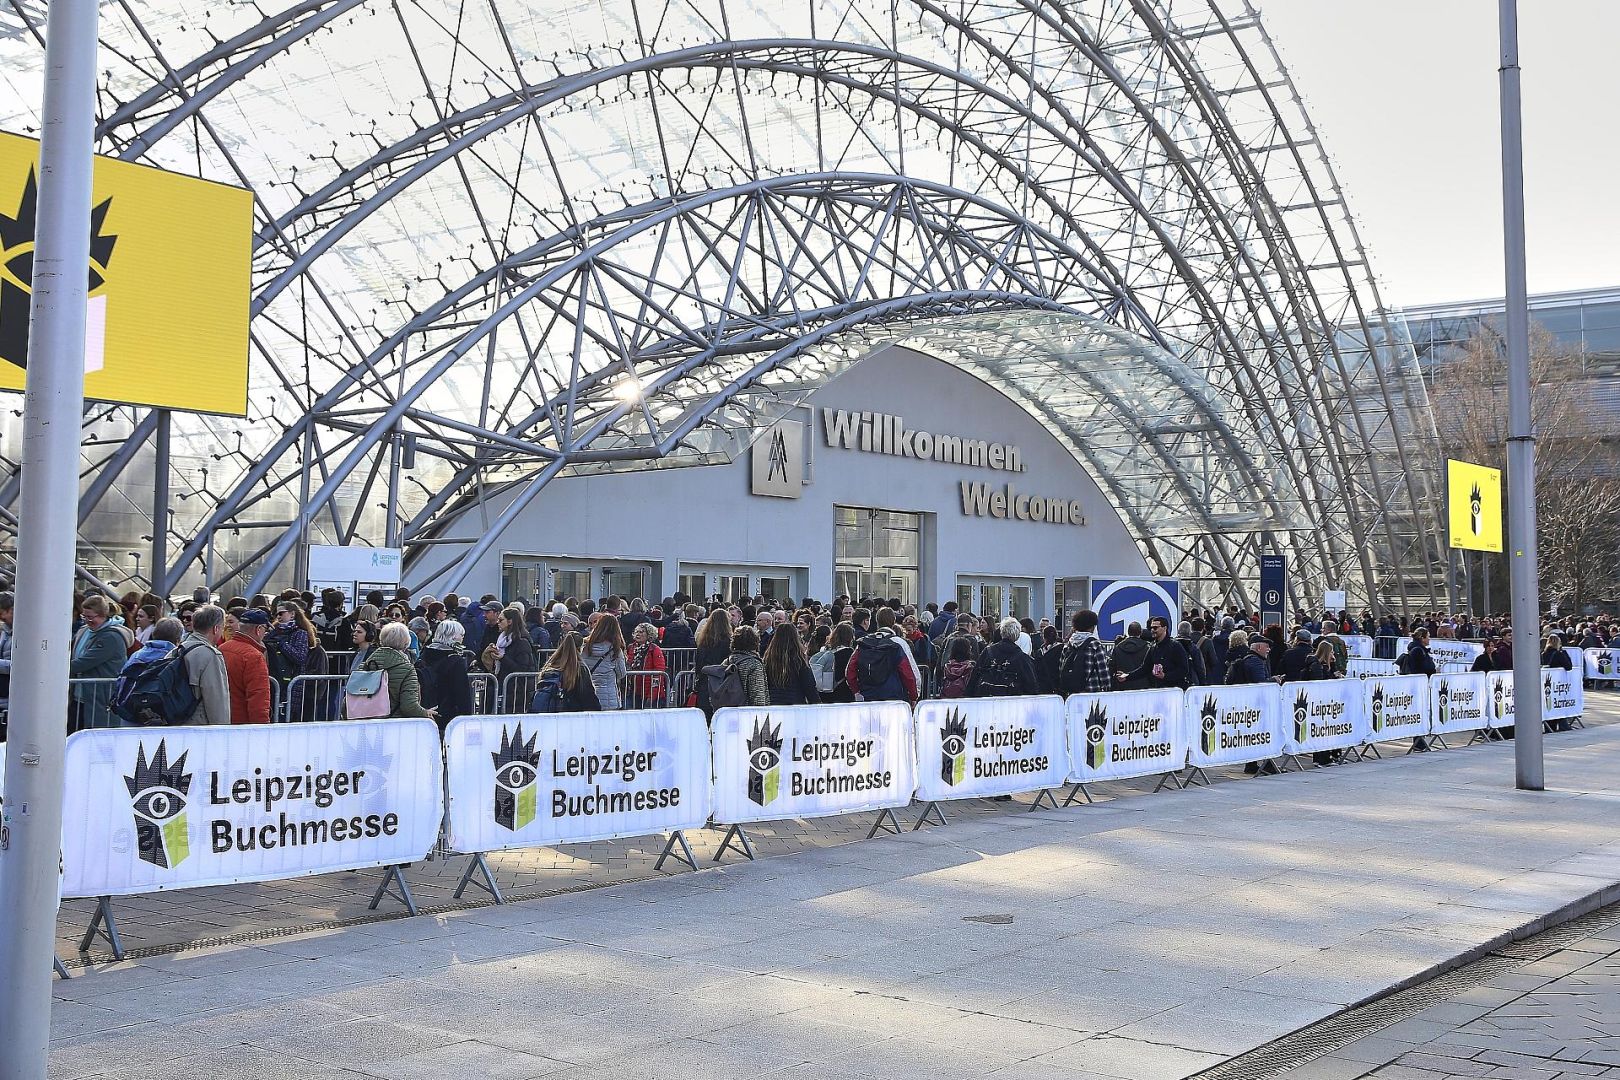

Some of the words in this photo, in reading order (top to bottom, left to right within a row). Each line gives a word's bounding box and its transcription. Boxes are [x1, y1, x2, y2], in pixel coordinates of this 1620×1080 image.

[823, 407, 1027, 473] Willkommen.
[961, 480, 1087, 526] Welcome.
[1269, 593, 1276, 603] H
[1310, 699, 1345, 720] Leipziger
[1385, 692, 1414, 711] Leipziger
[1450, 689, 1475, 705] Leipziger
[1220, 705, 1261, 730] Leipziger
[1385, 710, 1421, 727] Buchmesse
[1450, 707, 1480, 720] Buchmesse
[973, 725, 1035, 753] Leipziger
[1112, 714, 1161, 741] Leipziger
[1220, 728, 1271, 749] Buchmesse
[1310, 721, 1352, 738] Buchmesse
[791, 732, 874, 767] Leipziger
[1111, 738, 1171, 763] Buchmesse
[552, 745, 657, 785] Leipziger
[973, 750, 1049, 778] Buchmesse
[210, 764, 365, 812] Leipziger
[791, 766, 892, 798] Buchmesse
[552, 783, 680, 818] Buchmesse
[211, 811, 399, 854] Buchmesse
